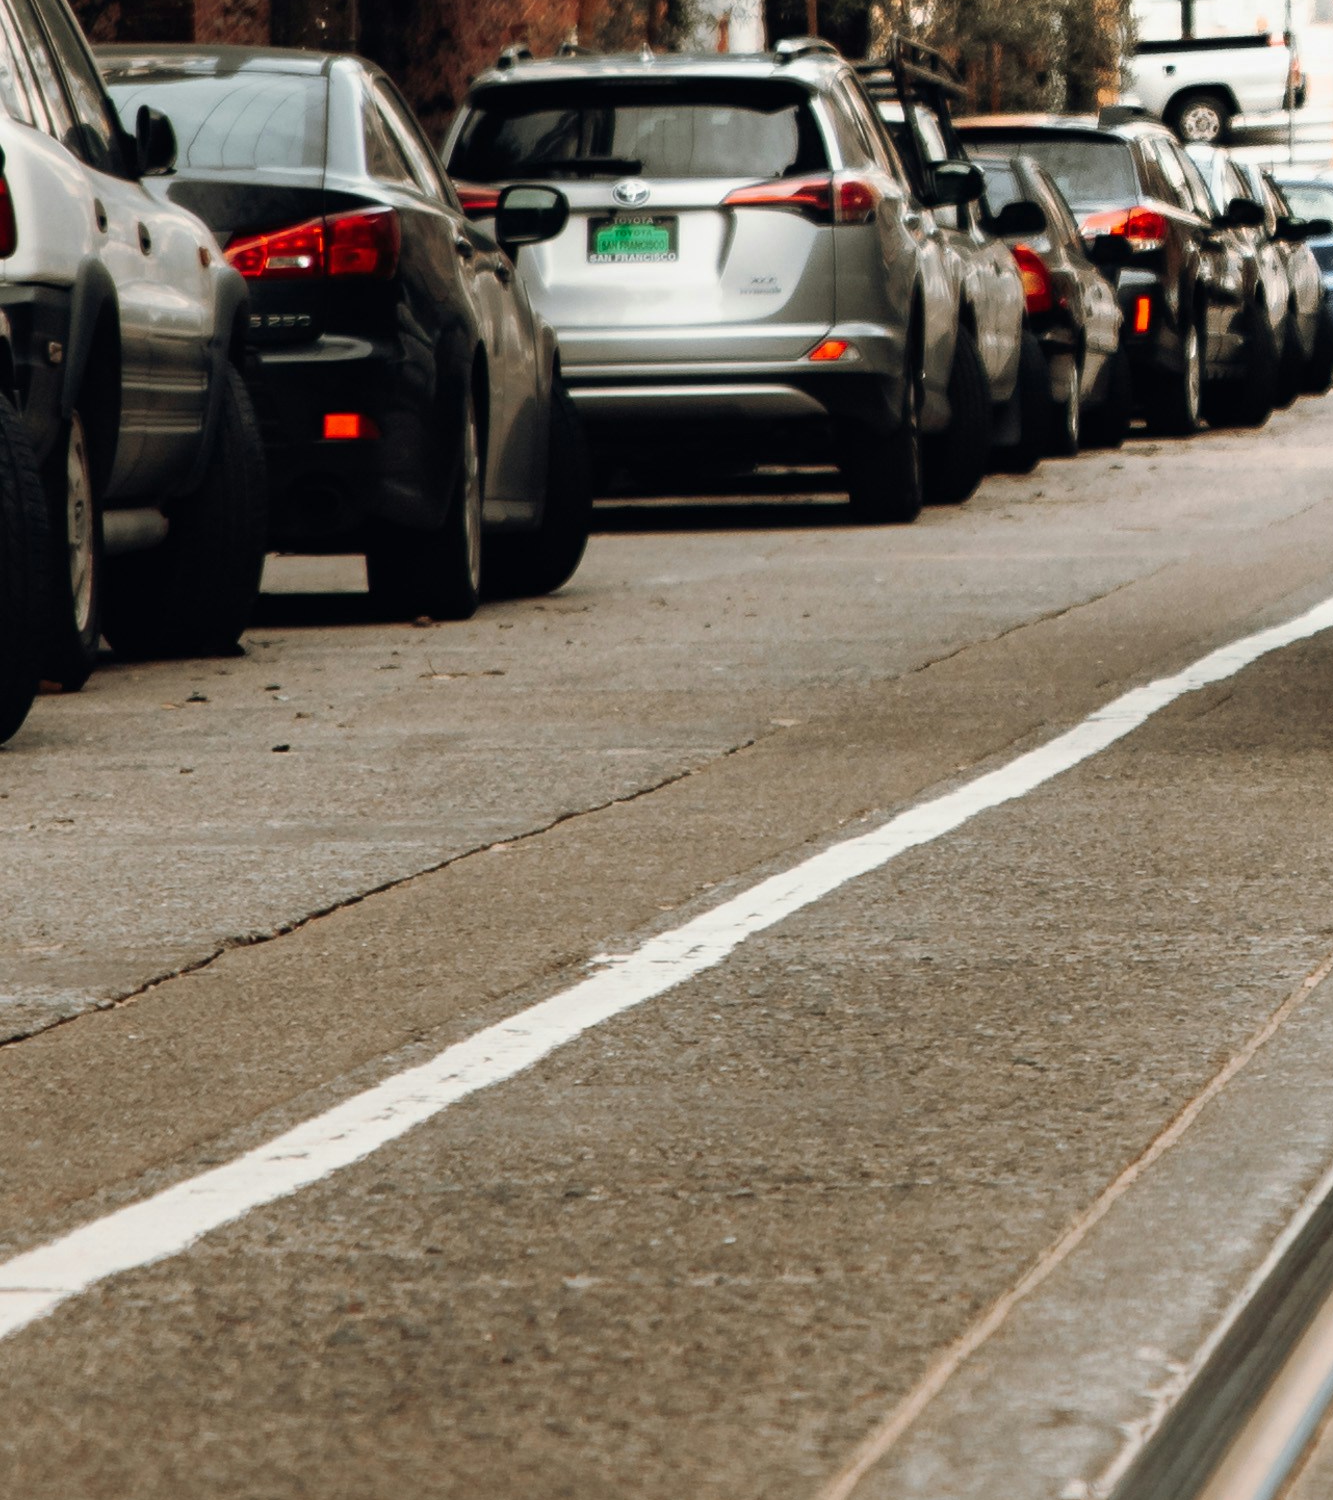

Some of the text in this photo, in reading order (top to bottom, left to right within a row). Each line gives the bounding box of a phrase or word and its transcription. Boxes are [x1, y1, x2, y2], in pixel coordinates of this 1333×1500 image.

[614, 217, 654, 225] TOYOTA
[614, 229, 653, 238] TOYOTA
[601, 241, 617, 251] SAN
[589, 252, 676, 262] SAN FRANCISCO
[268, 314, 311, 328] 250
